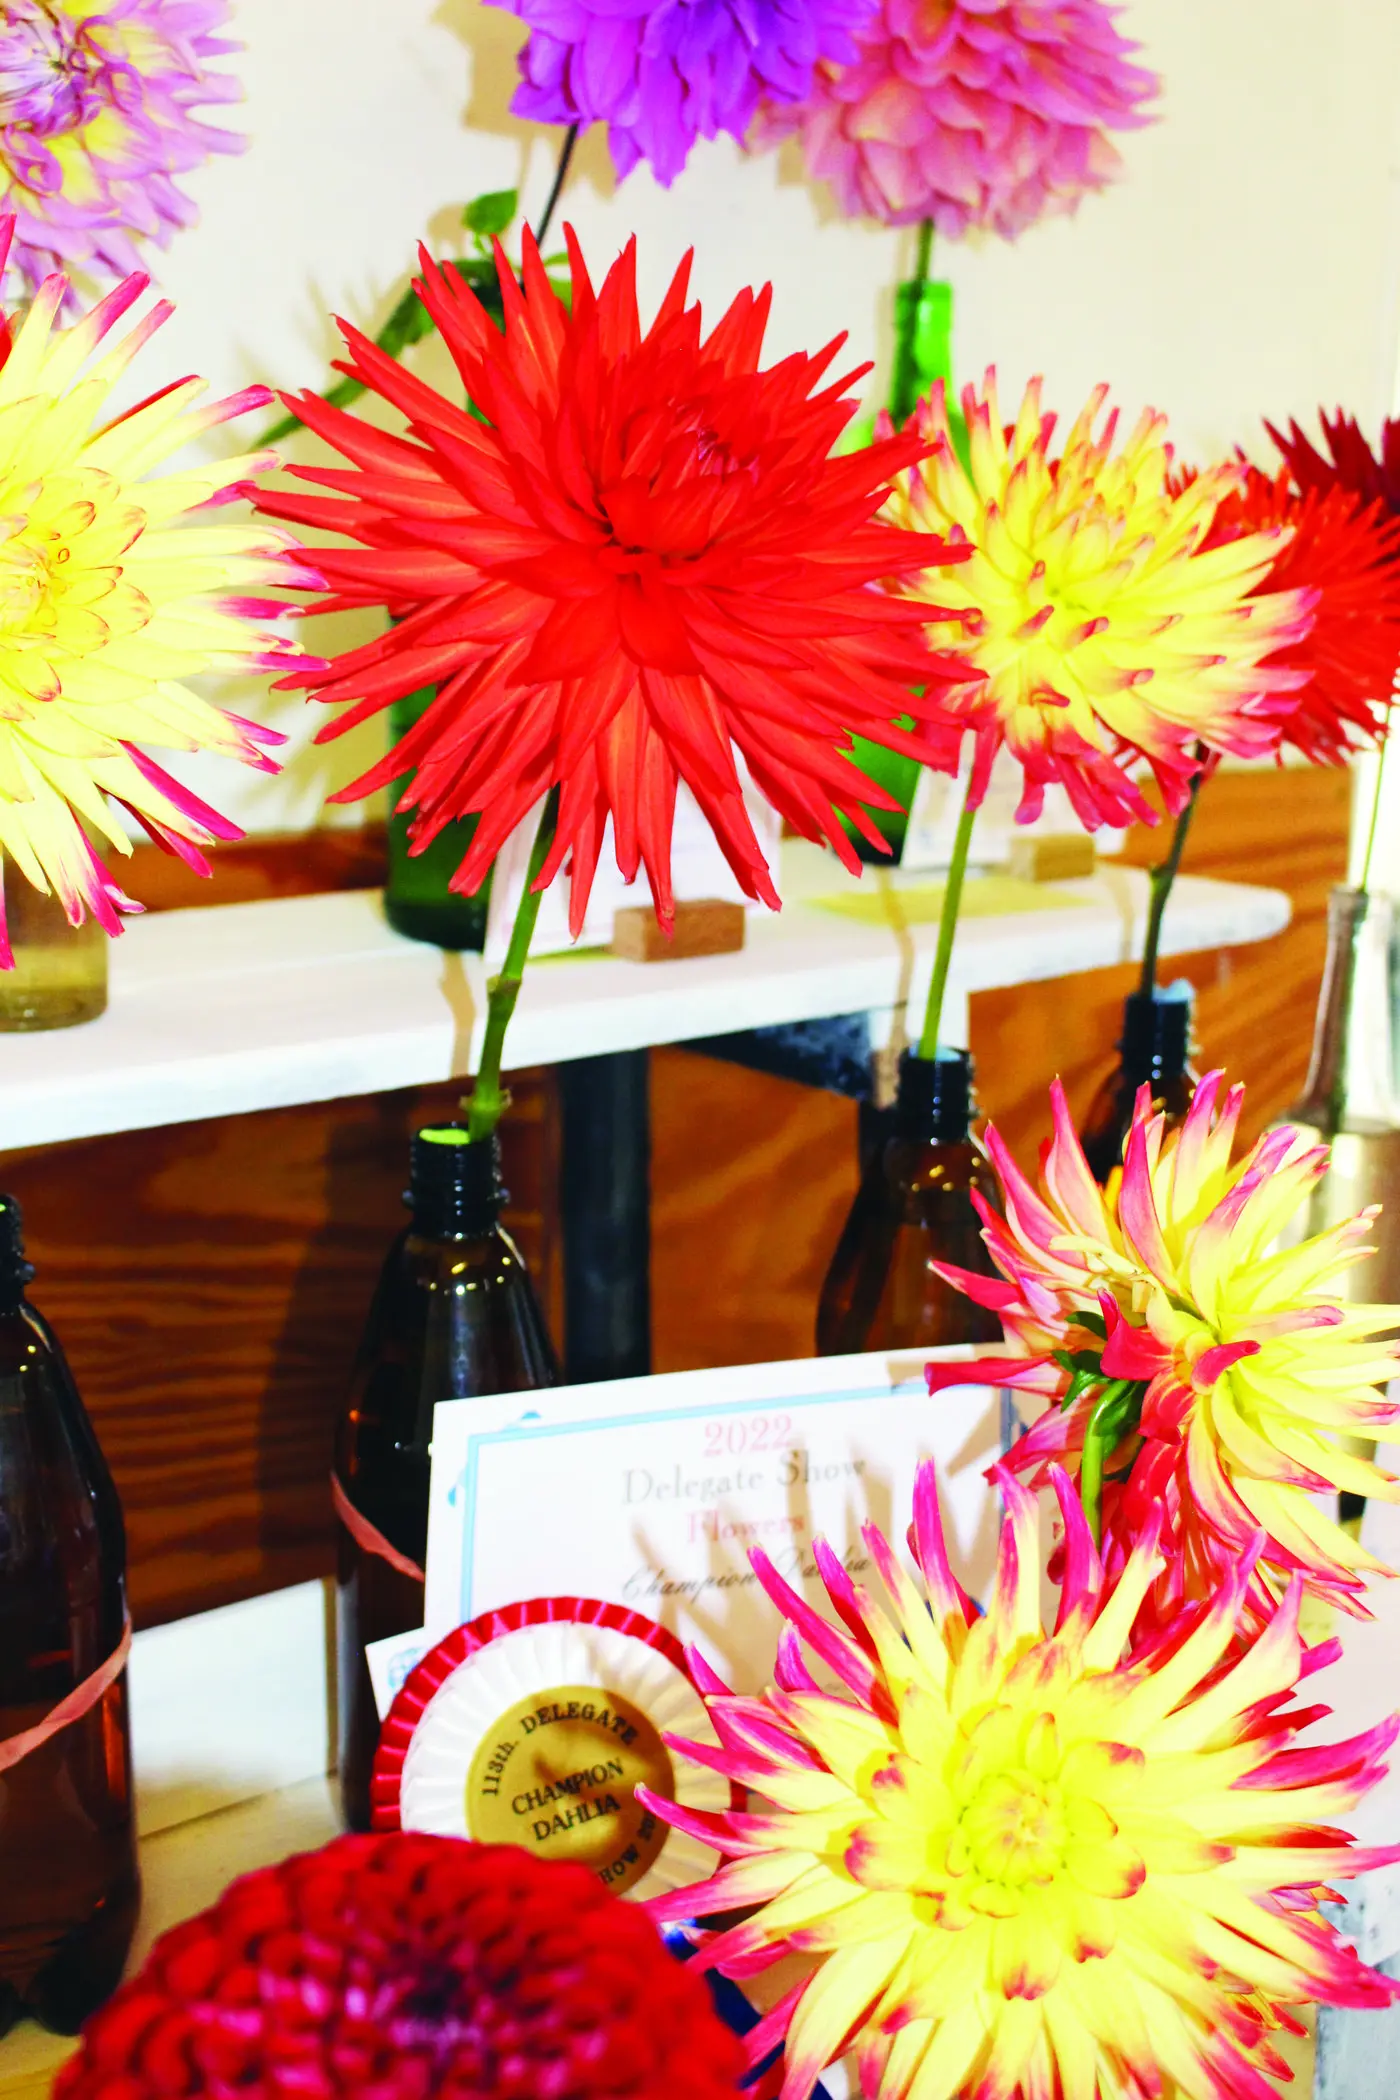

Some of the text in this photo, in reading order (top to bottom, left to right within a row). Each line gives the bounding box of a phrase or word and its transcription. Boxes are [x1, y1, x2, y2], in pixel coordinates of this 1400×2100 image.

[703, 1415, 793, 1457] 2022
[622, 1449, 867, 1504] Delegate Show
[686, 1508, 806, 1544] Flowers
[622, 1563, 756, 1604] Champion
[520, 1701, 639, 1746] DELEGATE
[511, 1757, 625, 1816] CHAMPION
[533, 1793, 622, 1841] DAHLIA
[598, 1843, 640, 1885] HOW
